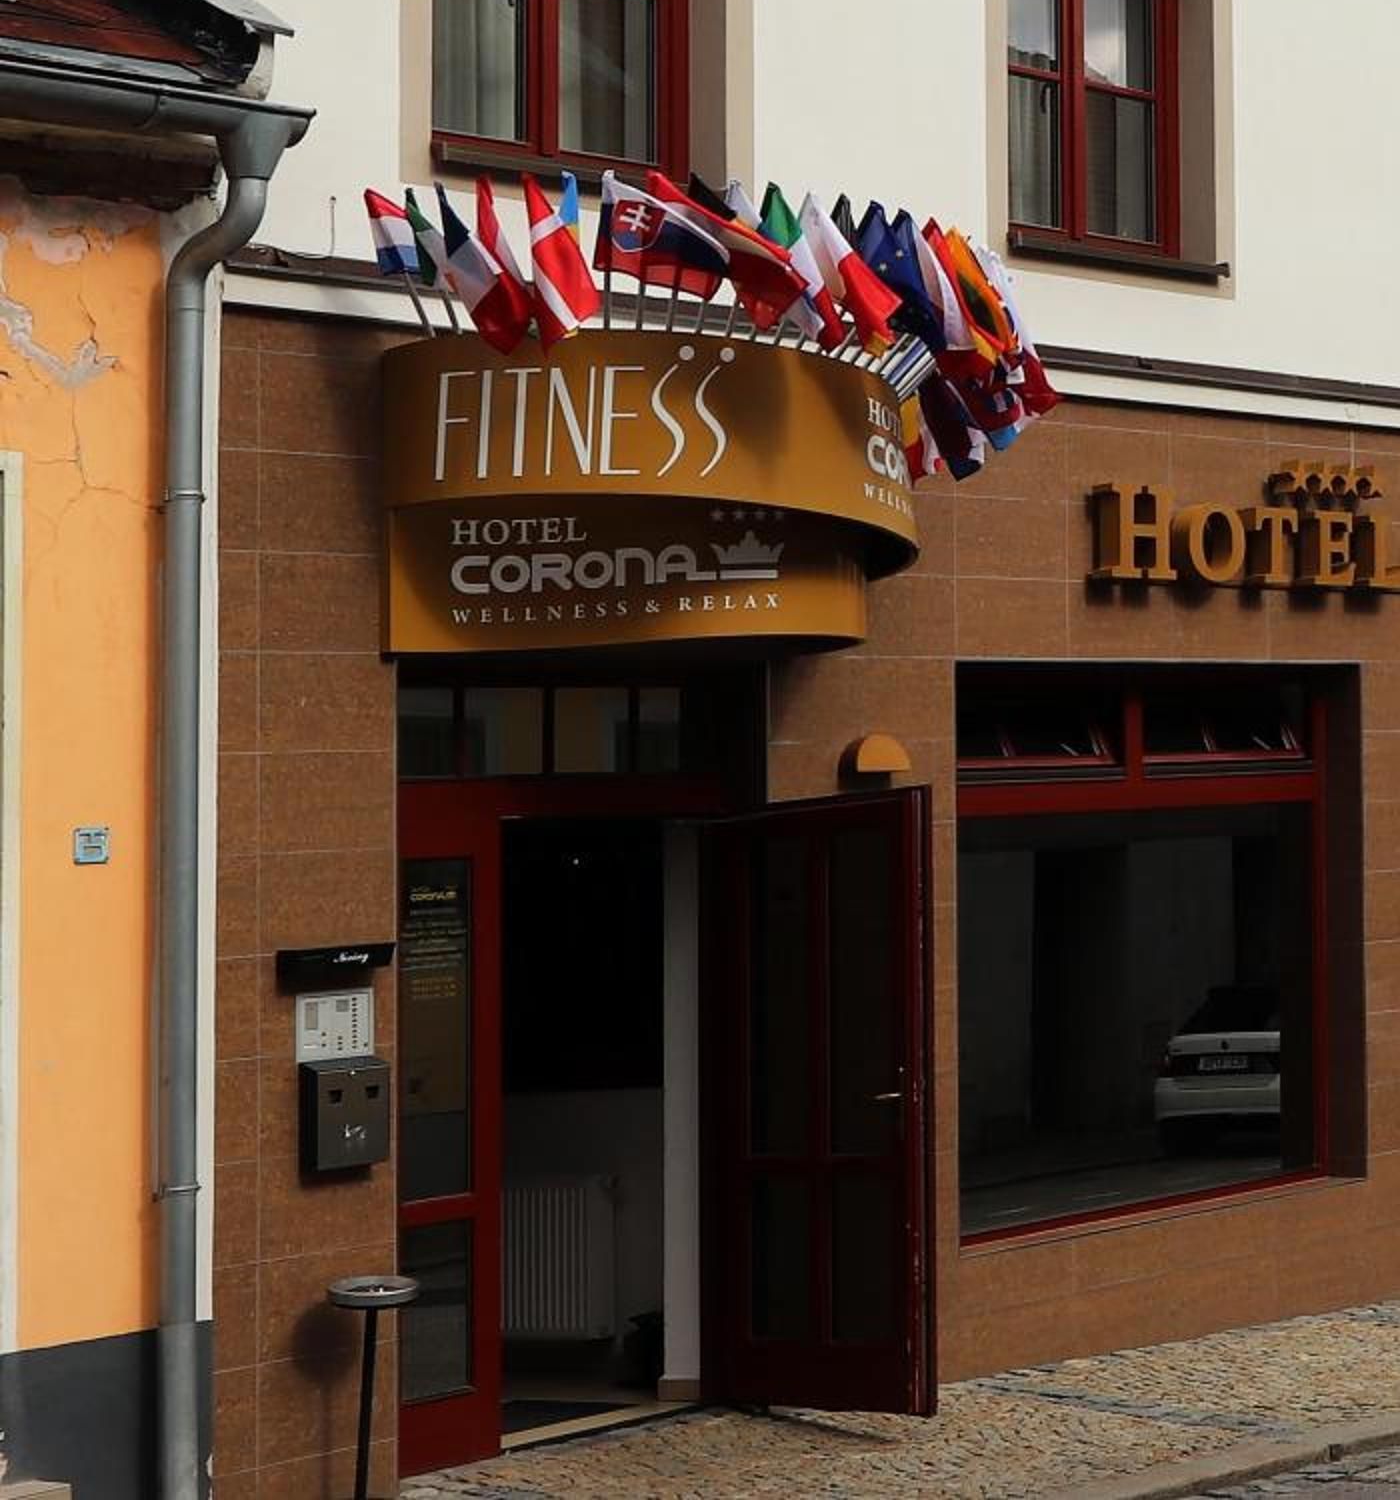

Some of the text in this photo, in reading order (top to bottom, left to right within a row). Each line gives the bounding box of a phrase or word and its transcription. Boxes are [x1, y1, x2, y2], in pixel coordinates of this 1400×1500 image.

[433, 345, 737, 481] FITNESS
[450, 517, 717, 595] HOTEL CORONA
[452, 593, 781, 624] WELLNESS & RELAX
